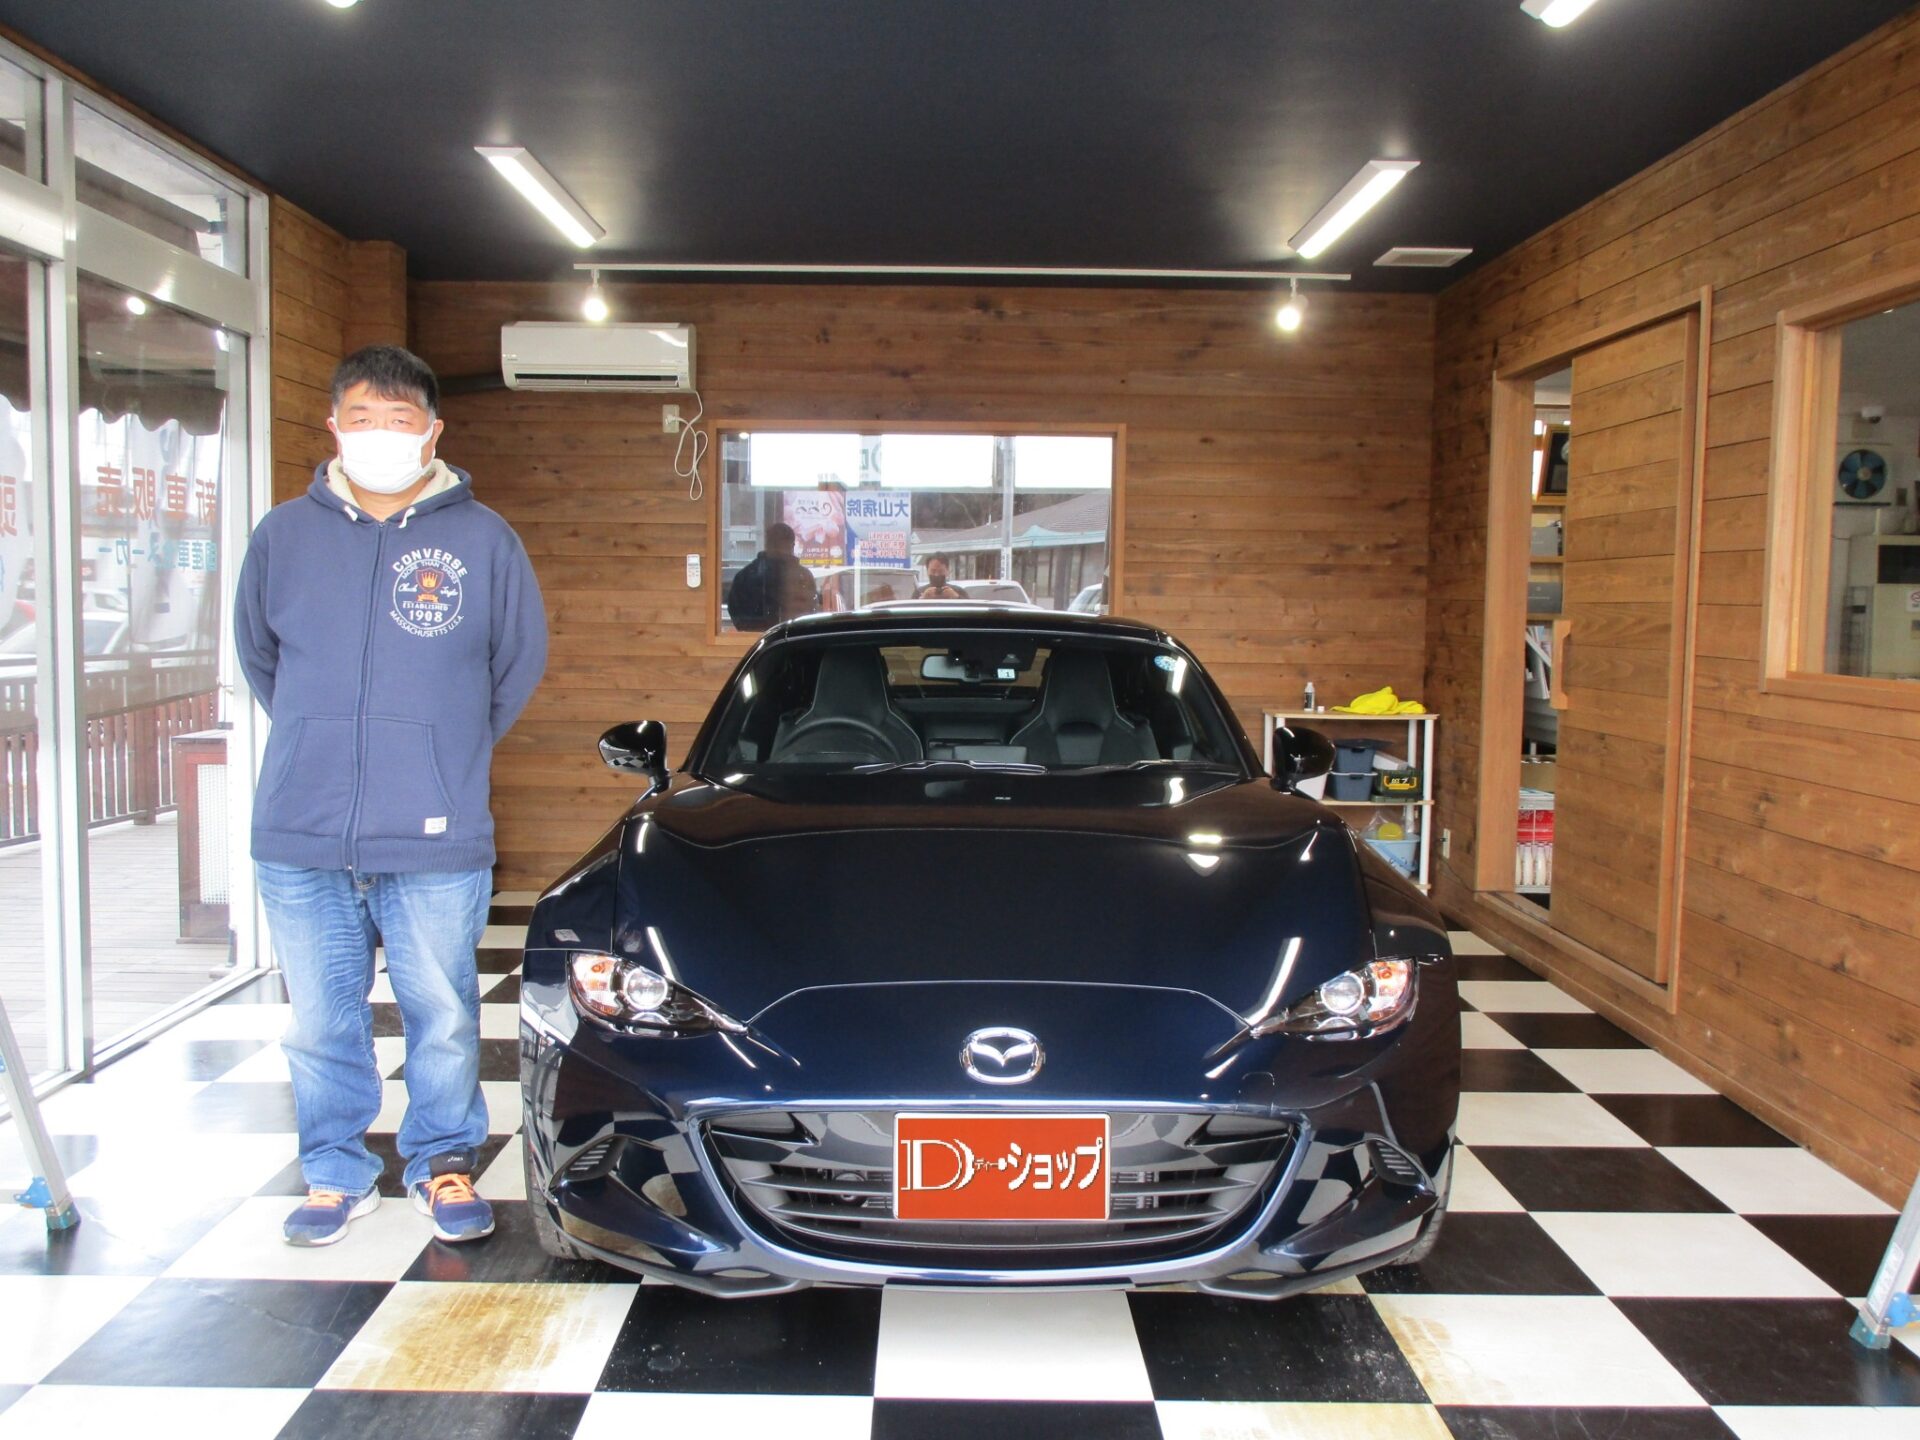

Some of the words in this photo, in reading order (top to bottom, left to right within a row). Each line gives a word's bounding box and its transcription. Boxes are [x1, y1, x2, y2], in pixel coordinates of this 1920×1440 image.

[392, 548, 468, 577] CONVERSE
[402, 602, 449, 611] ESTABLISHED
[409, 610, 443, 623] 1908
[389, 610, 448, 637] MASSACHUSETTS
